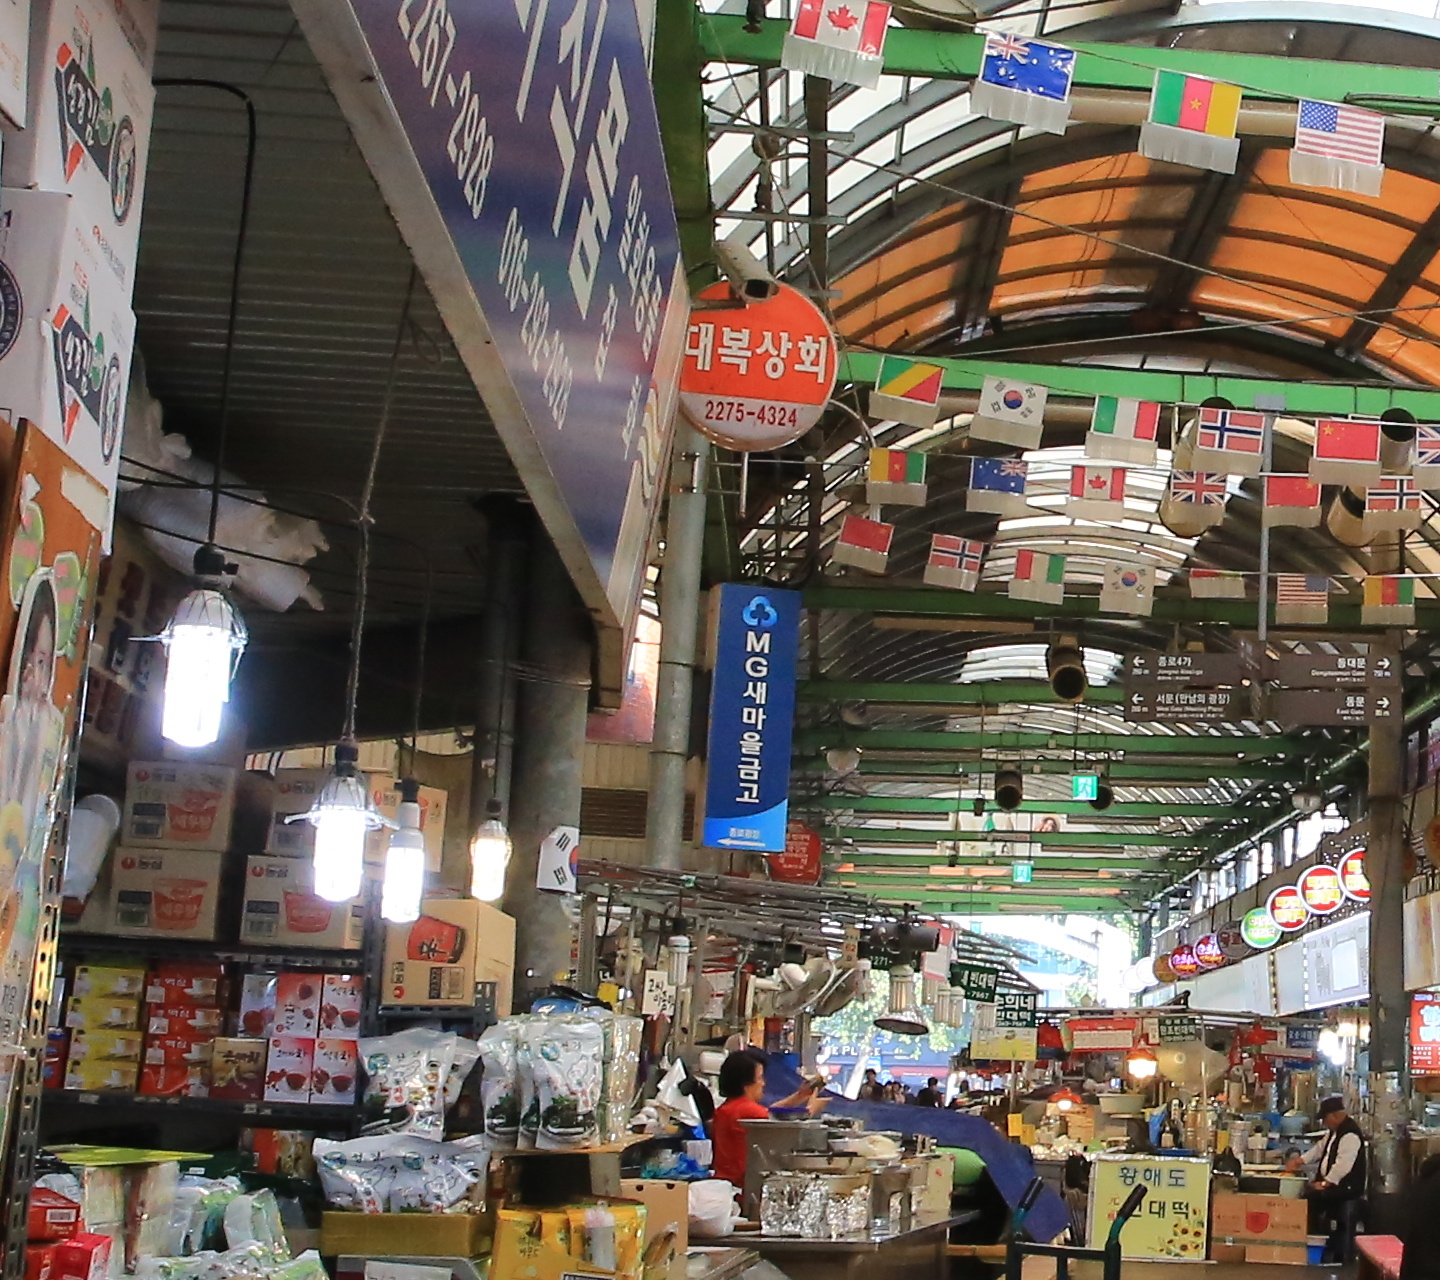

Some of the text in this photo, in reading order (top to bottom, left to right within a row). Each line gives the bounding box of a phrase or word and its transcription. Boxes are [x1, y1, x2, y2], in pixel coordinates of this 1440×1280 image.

[684, 322, 830, 387] 대복상회
[705, 400, 798, 426] 2275-4324
[1337, 658, 1367, 668] 동대문
[1156, 694, 1174, 705] 서문
[1345, 696, 1365, 707] 동문
[735, 631, 771, 804] MG새마을금고
[1118, 1165, 1185, 1188] 황해도
